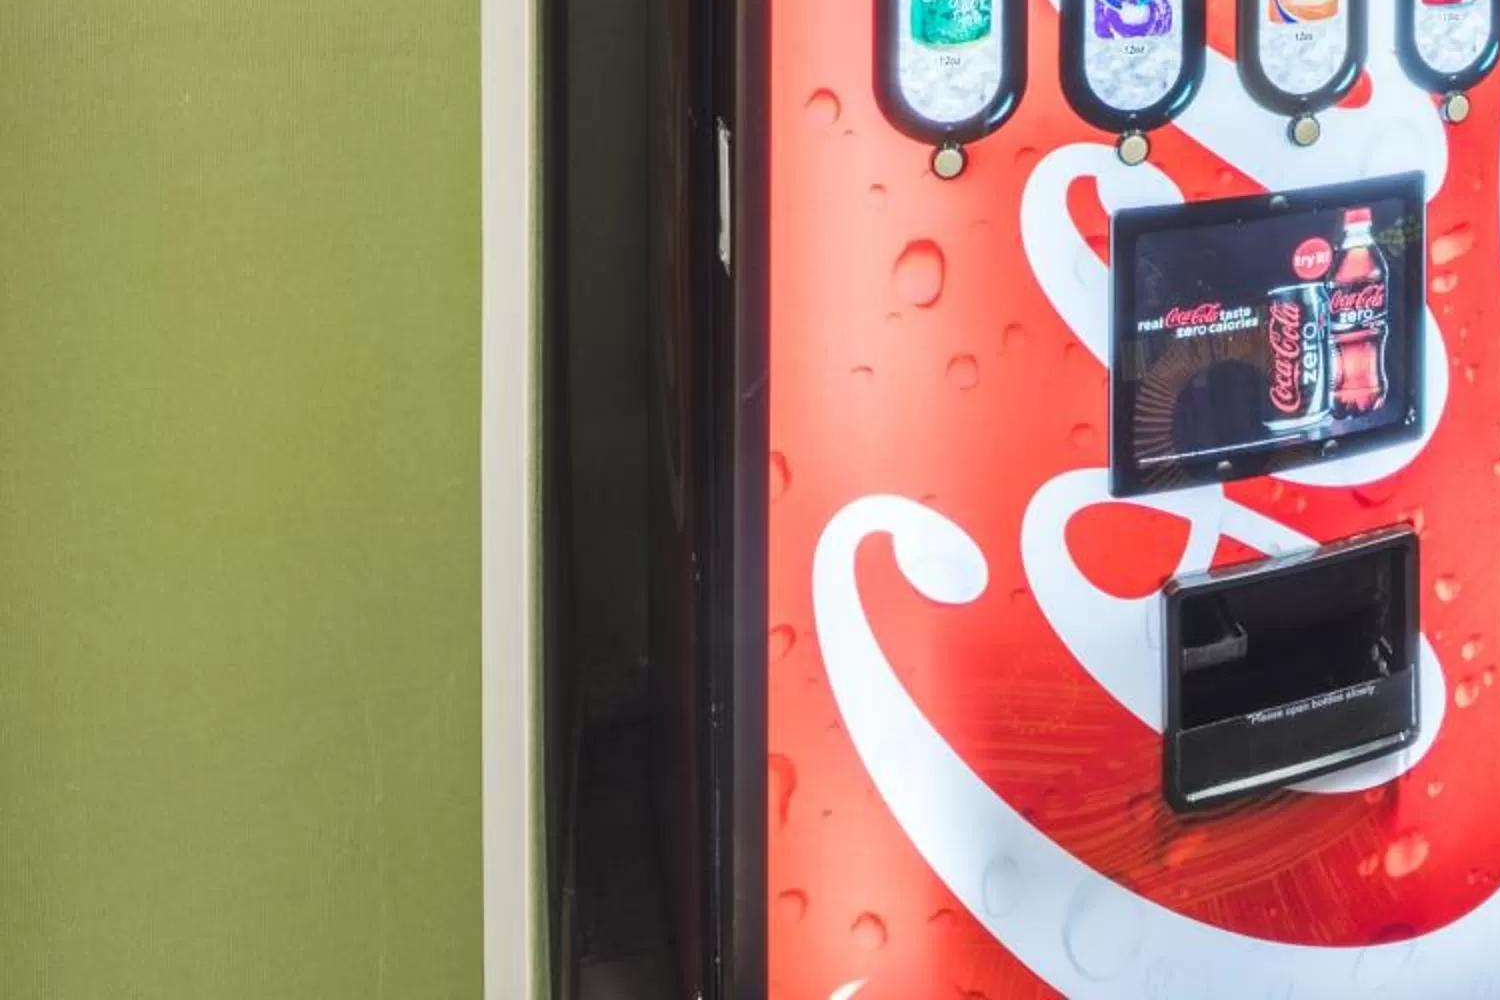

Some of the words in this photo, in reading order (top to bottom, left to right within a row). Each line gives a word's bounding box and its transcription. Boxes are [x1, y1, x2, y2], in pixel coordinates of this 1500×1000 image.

[1294, 252, 1315, 269] try
[1137, 316, 1164, 332] real
[1219, 307, 1251, 321] taste
[1340, 309, 1373, 324] zero
[1176, 324, 1207, 339] zero
[1208, 317, 1258, 333] calories
[1302, 321, 1319, 385] zero
